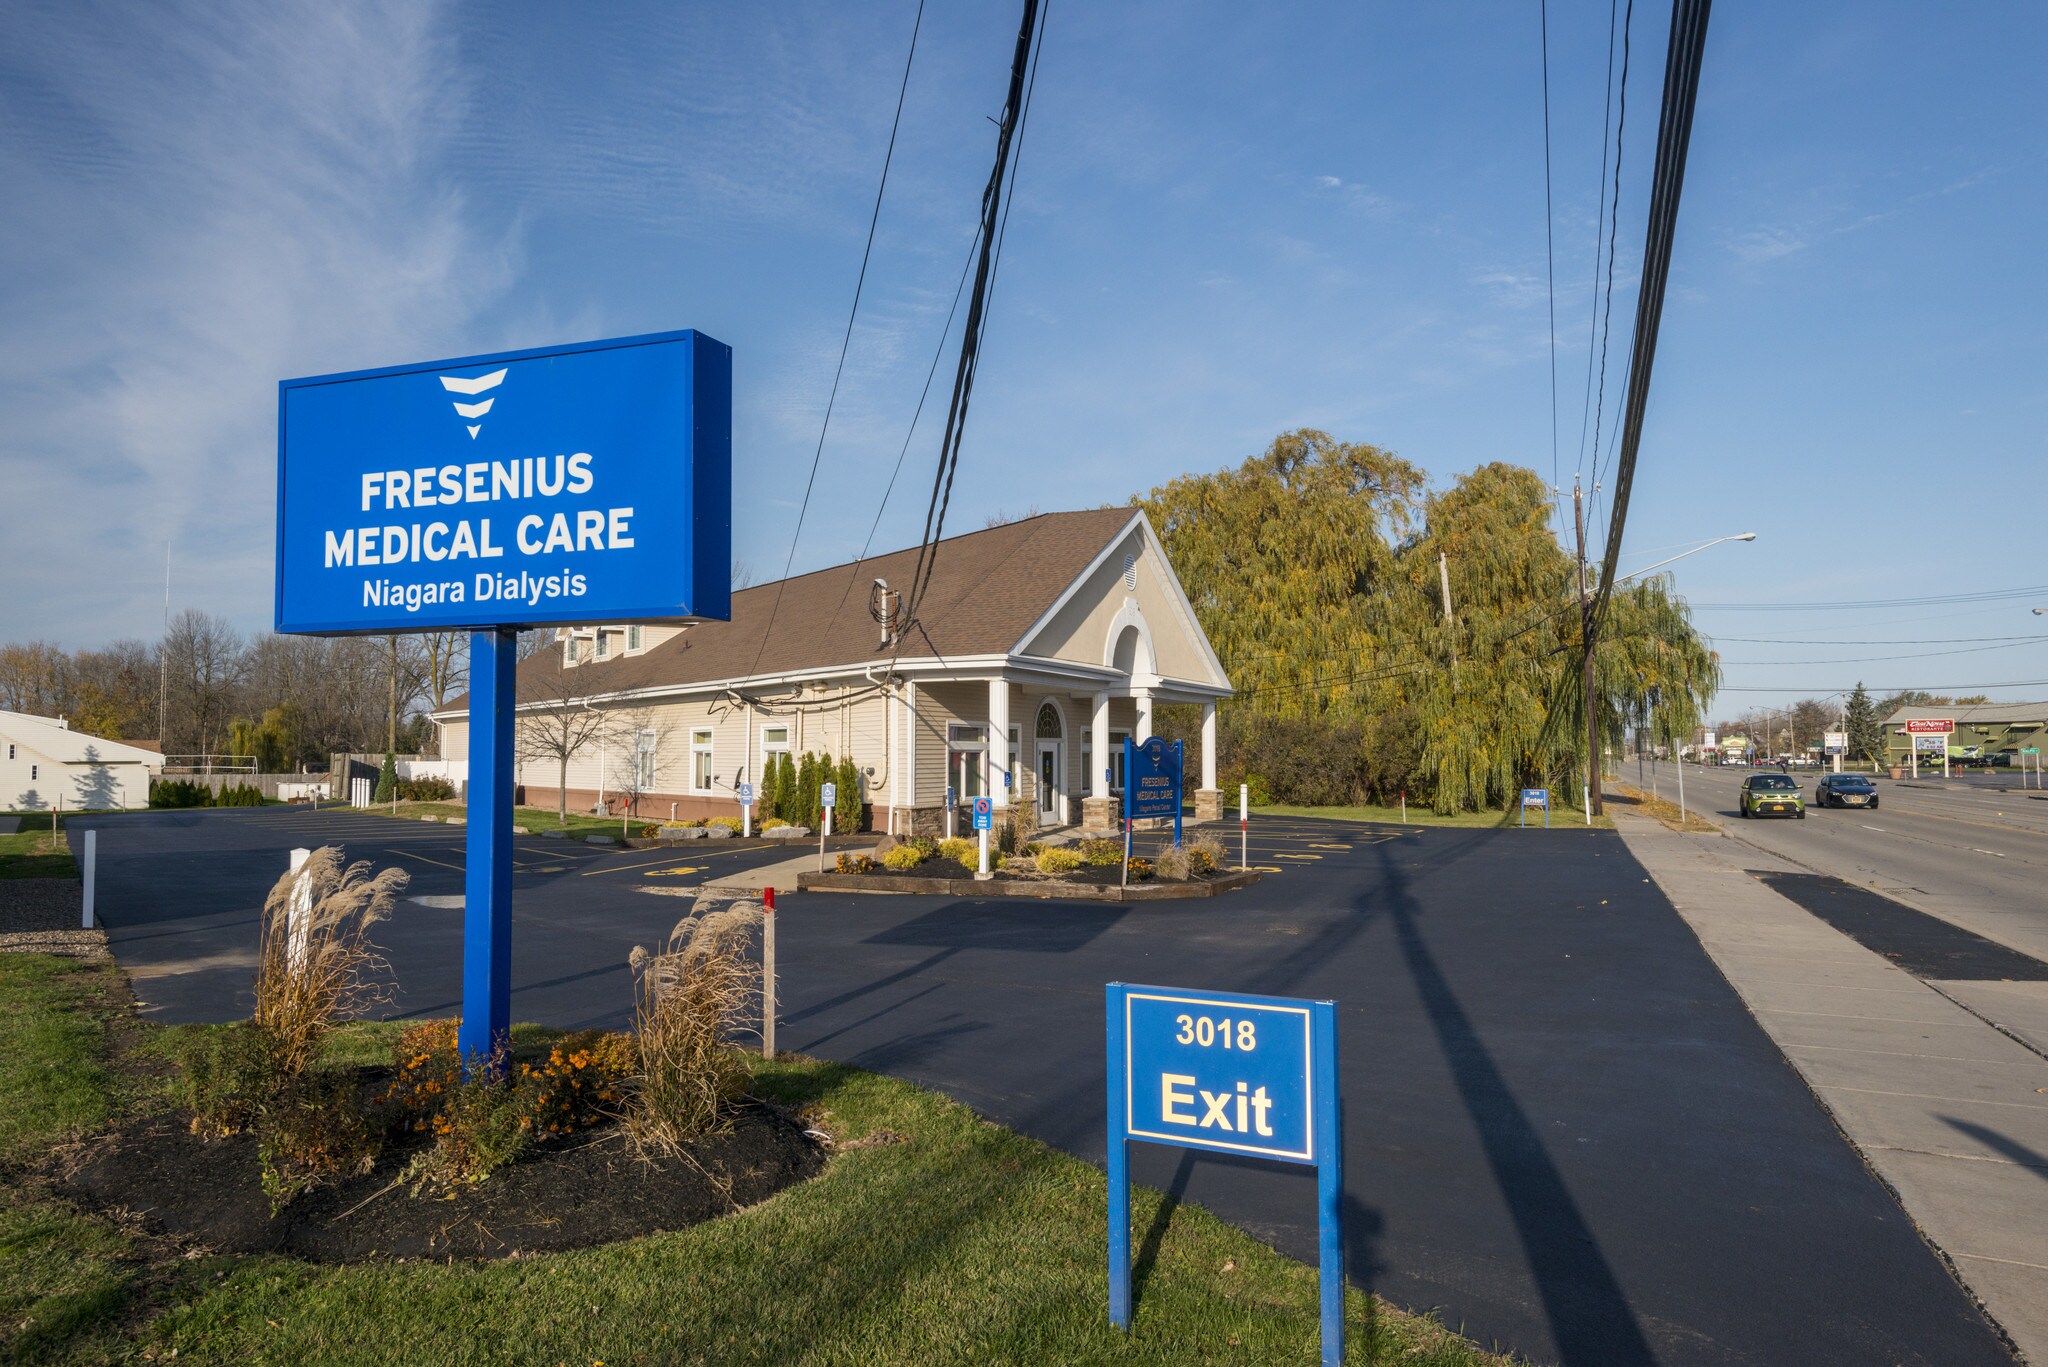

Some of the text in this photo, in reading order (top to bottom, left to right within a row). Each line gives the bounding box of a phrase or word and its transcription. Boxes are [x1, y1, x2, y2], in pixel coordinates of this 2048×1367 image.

[361, 452, 594, 511] FRESENIUS
[324, 507, 635, 568] MEDICAL CARE
[363, 568, 587, 612] Niagara Dialysis
[1136, 790, 1173, 801] MEDICAL CARE
[1142, 777, 1169, 787] FRESENIUS
[1176, 1014, 1257, 1051] 3018
[1161, 1072, 1273, 1137] Exit
